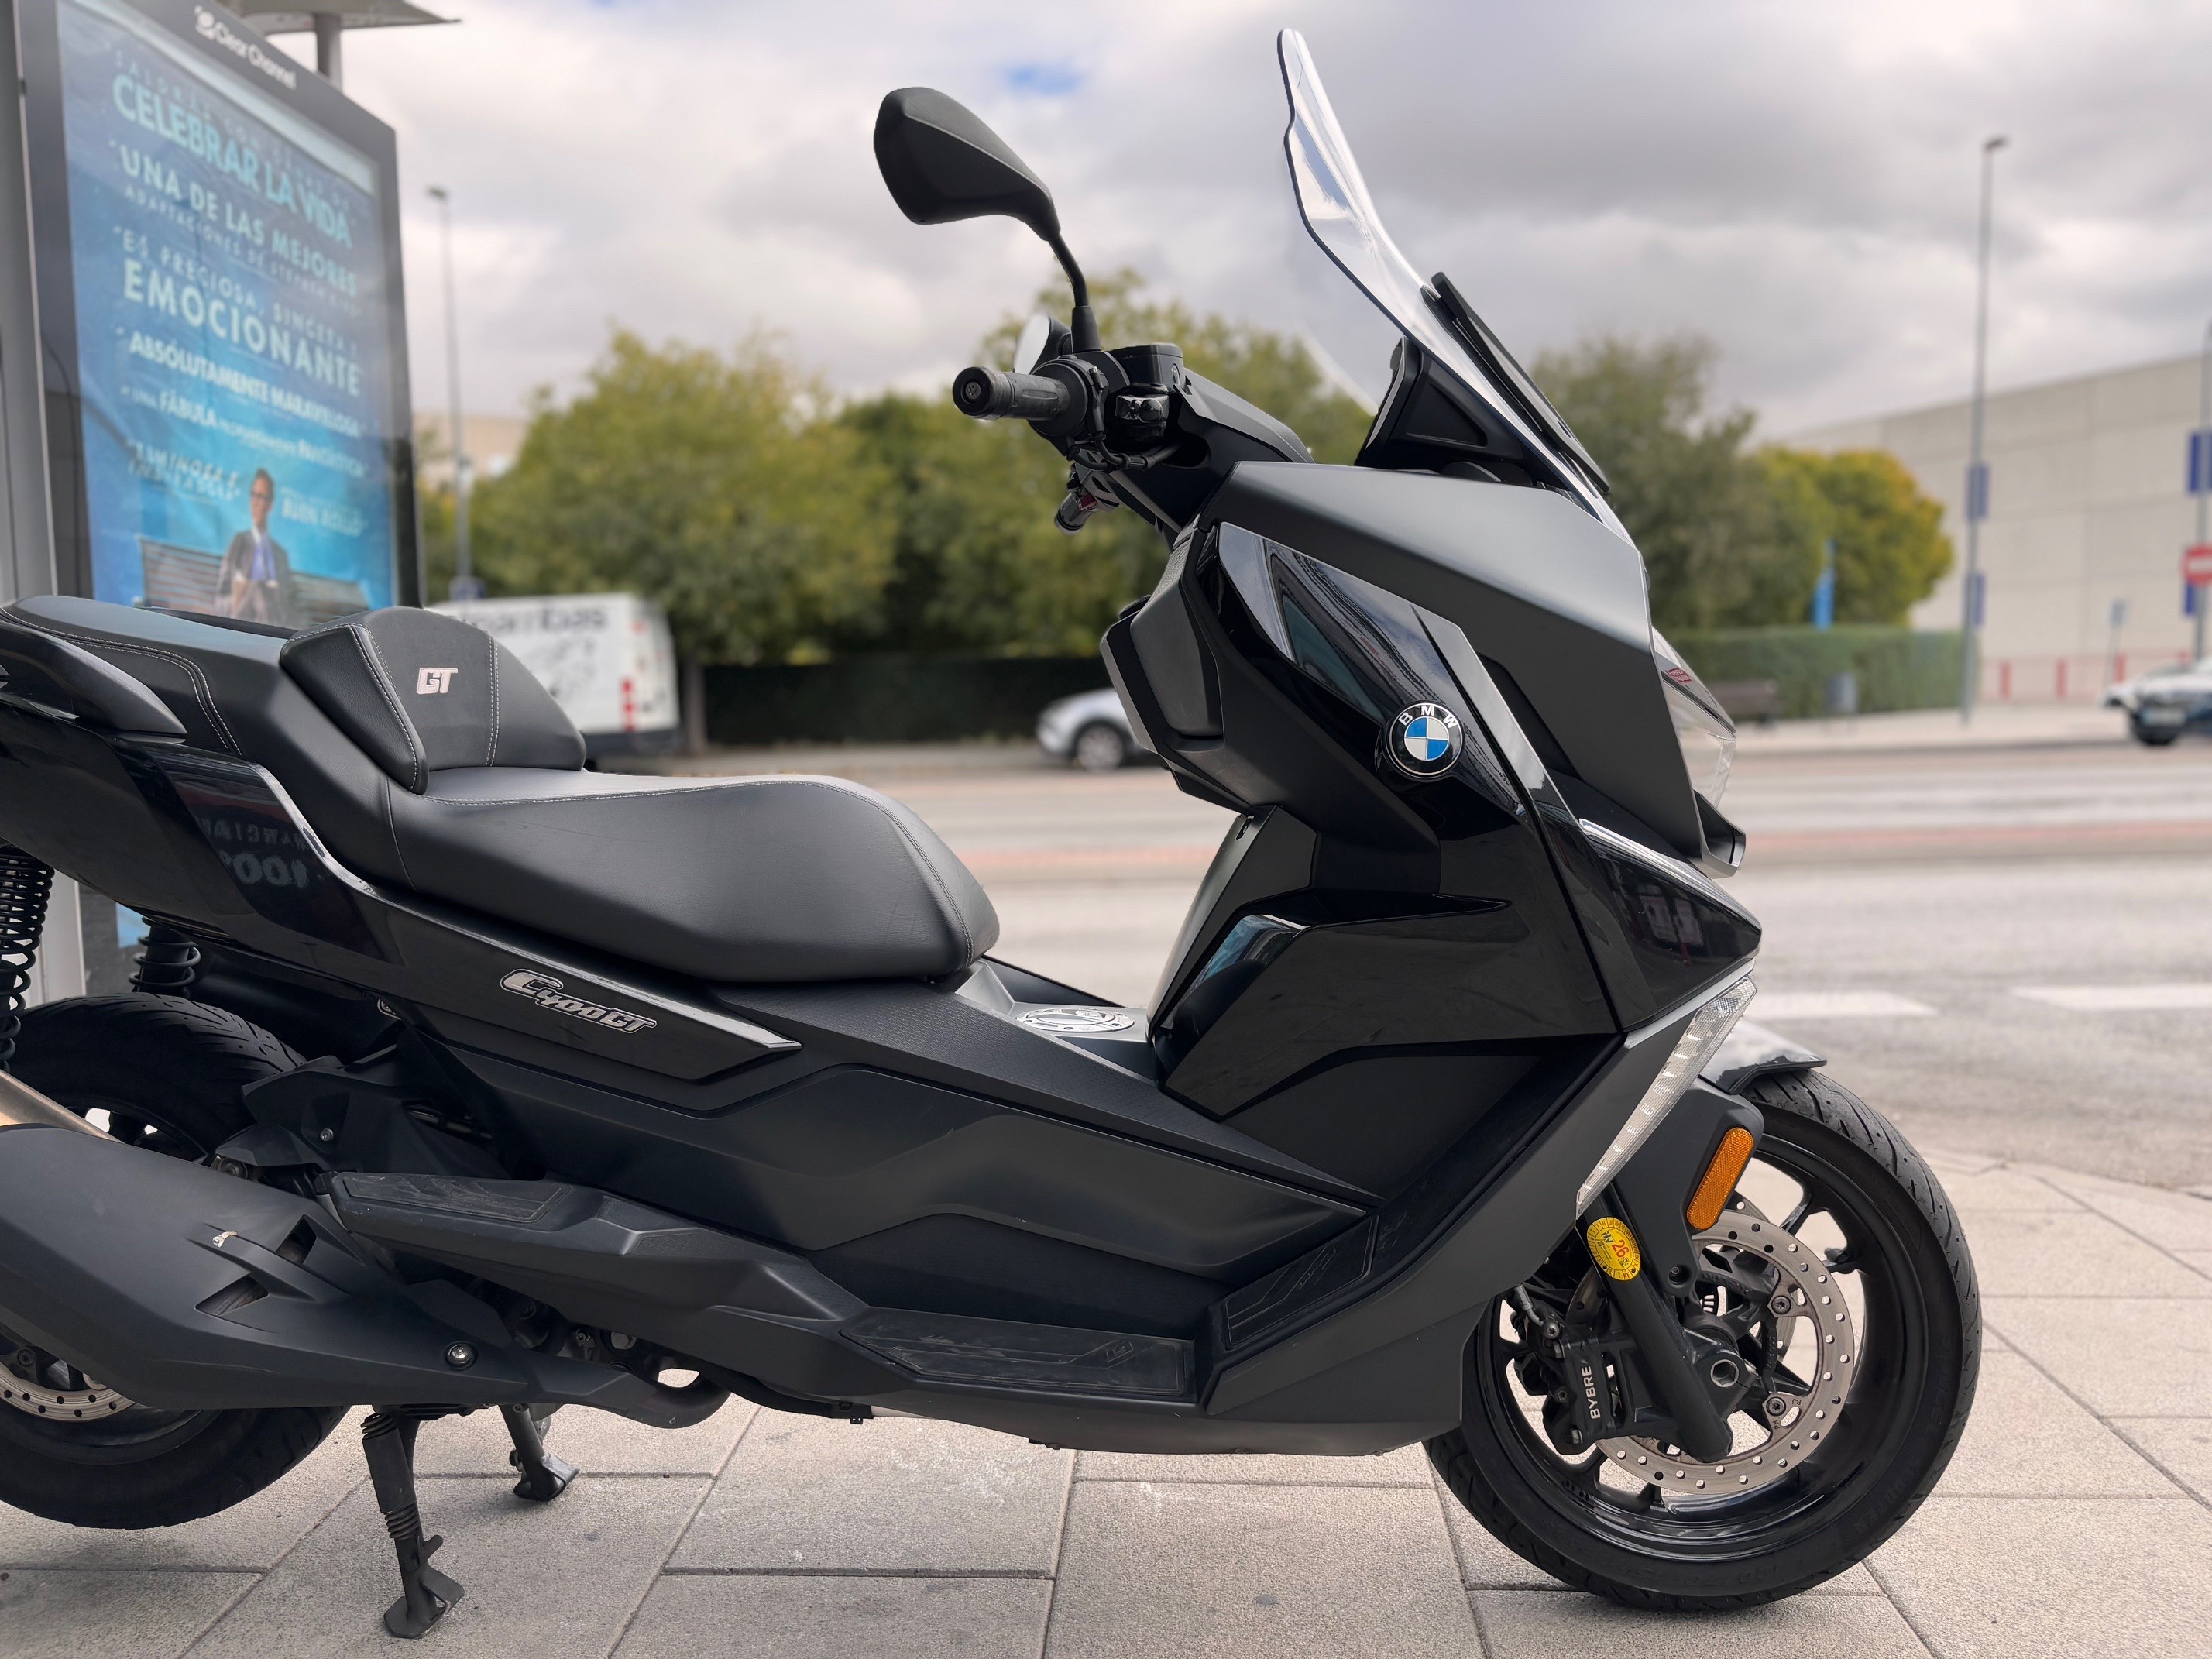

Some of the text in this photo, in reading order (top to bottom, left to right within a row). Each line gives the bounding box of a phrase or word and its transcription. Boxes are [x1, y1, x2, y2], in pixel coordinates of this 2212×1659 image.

[215, 21, 297, 91] Clear Channel
[112, 73, 260, 194] CELEBRAR
[264, 160, 299, 215] LA
[189, 180, 219, 222] DE
[225, 201, 265, 248] LAS
[271, 228, 358, 297] MEJORES
[416, 667, 459, 695] GT
[1398, 704, 1458, 729] BMW
[1612, 1239, 1630, 1258] 26
[1581, 1365, 1601, 1419] BYBRE
